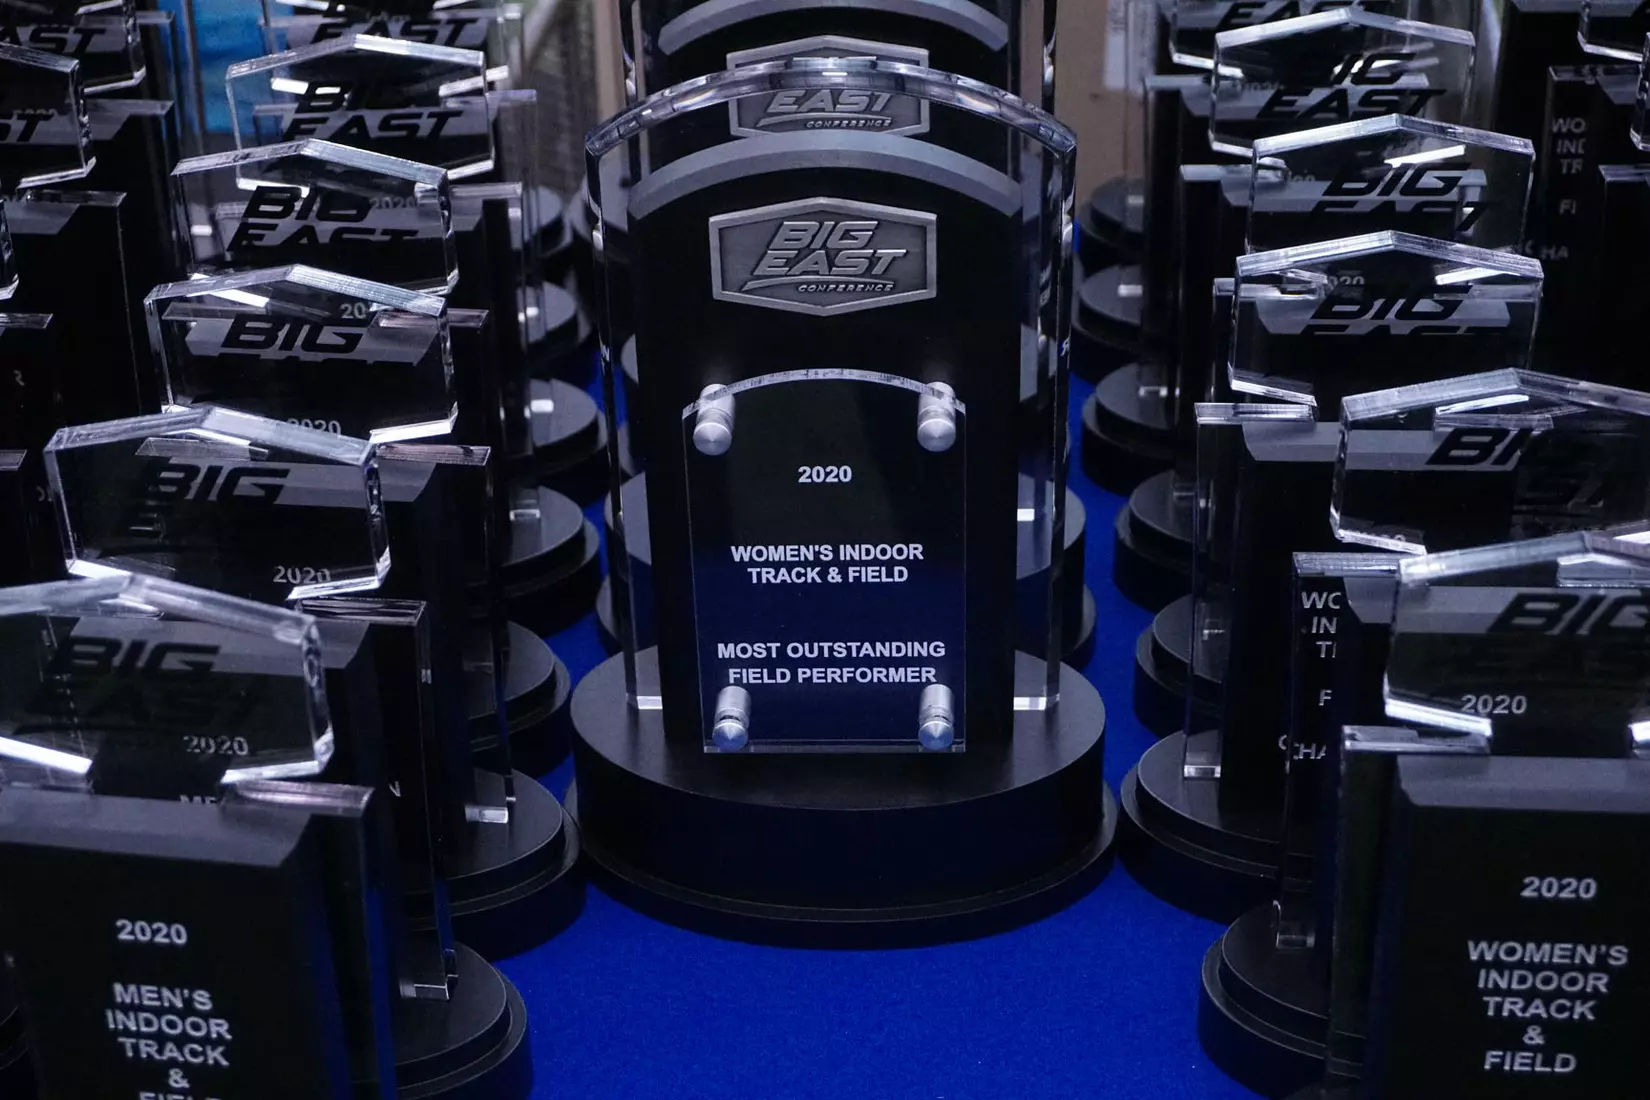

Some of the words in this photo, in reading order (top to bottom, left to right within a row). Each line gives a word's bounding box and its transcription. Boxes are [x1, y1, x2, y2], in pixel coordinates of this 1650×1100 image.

[1257, 89, 1447, 118] EAST
[284, 111, 464, 141] EAST
[805, 119, 893, 129] CONFERENCE
[768, 221, 878, 250] BIG
[752, 250, 908, 276] EAST
[797, 284, 895, 293] CONFERENCE
[221, 314, 368, 354] BIG
[798, 465, 852, 483] 2020
[731, 545, 833, 562] WOMEN'S
[839, 543, 924, 560] INDOOR
[747, 567, 822, 584] TRACK
[827, 567, 843, 583] &
[848, 566, 909, 583] FIELD
[717, 643, 781, 659] MOST
[786, 641, 946, 658] OUTSTANDING
[728, 668, 791, 685] FIELD
[797, 666, 937, 684] PERFORMER
[1460, 694, 1528, 715] 2020
[182, 735, 249, 756] 2020
[1520, 876, 1597, 899] 2020
[115, 919, 188, 945] 2020
[1467, 939, 1630, 966] WOMEN'S
[1478, 969, 1610, 993] INDOOR
[112, 981, 213, 1011] MEN'S
[1481, 996, 1597, 1020] TRACK
[105, 1008, 233, 1040] INDOOR
[1522, 1025, 1546, 1045] &
[117, 1036, 230, 1067] TRACK
[1484, 1050, 1578, 1073] FIELD
[168, 1068, 191, 1089] &
